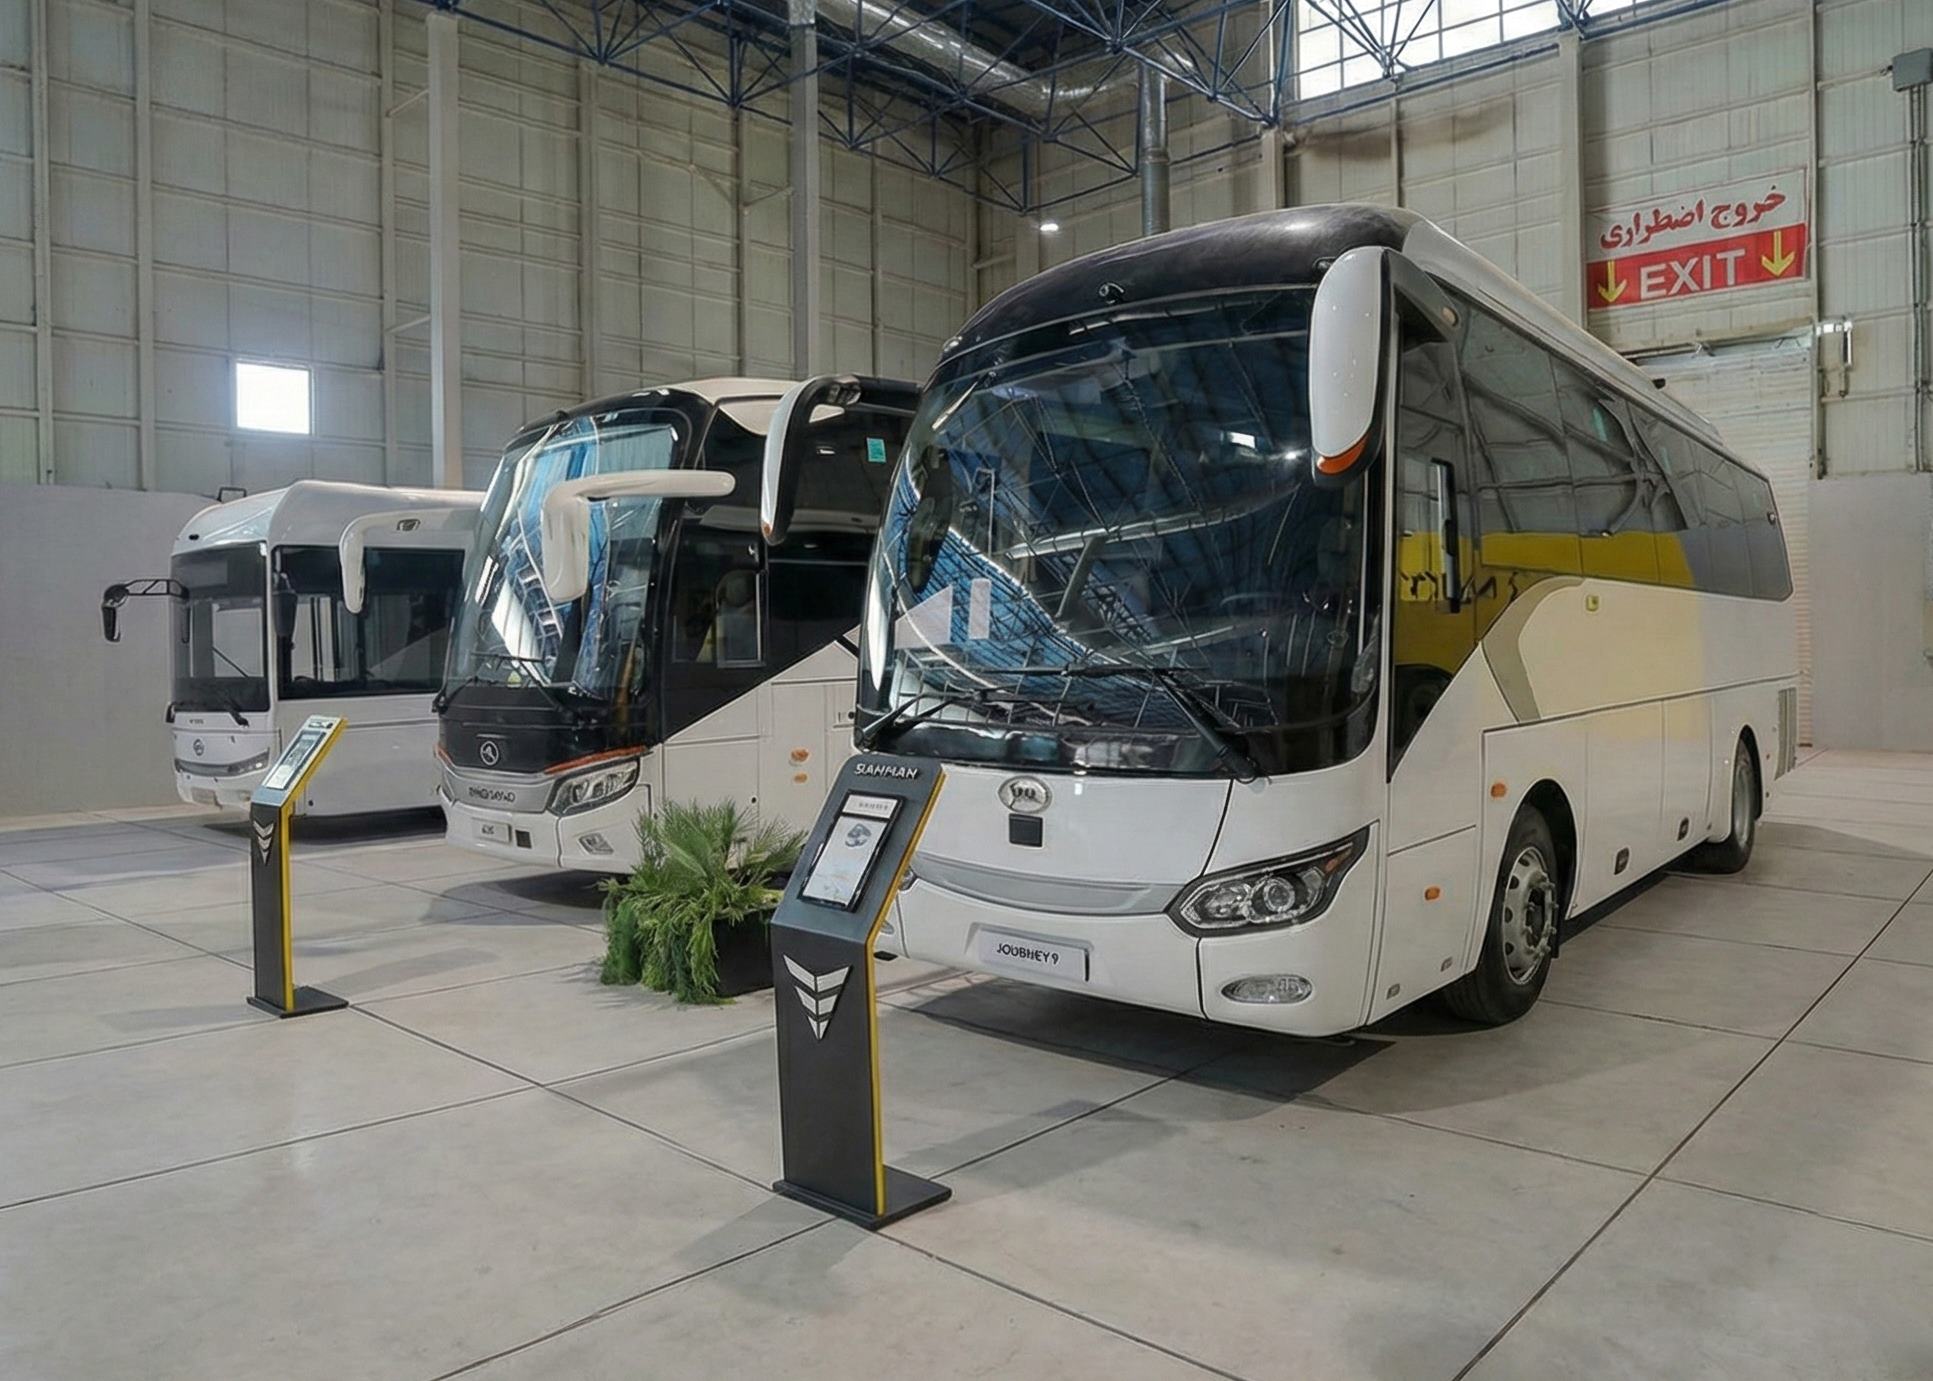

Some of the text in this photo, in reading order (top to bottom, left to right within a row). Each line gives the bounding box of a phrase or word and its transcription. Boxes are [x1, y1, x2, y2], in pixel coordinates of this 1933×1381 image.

[1600, 185, 1787, 249] خروج اضطراری
[1640, 248, 1746, 300] EXIT
